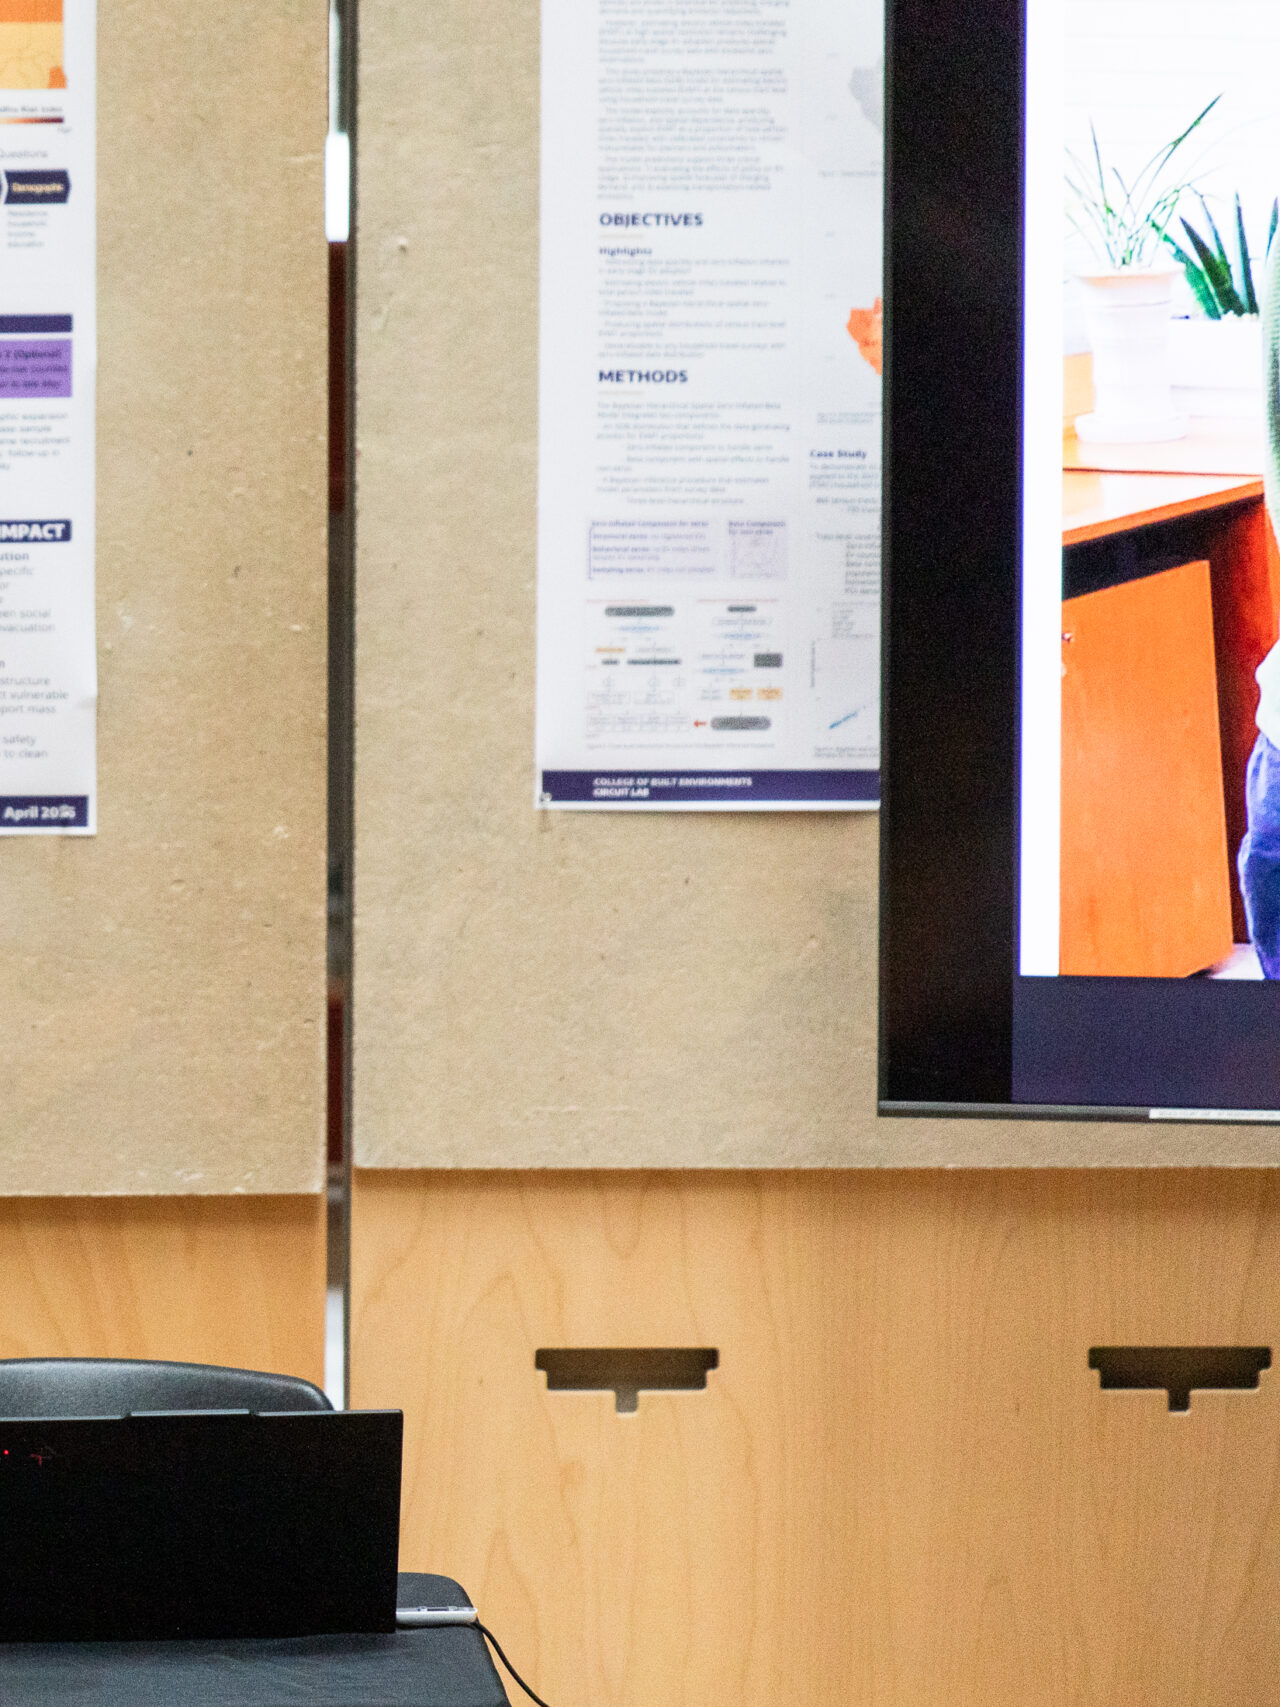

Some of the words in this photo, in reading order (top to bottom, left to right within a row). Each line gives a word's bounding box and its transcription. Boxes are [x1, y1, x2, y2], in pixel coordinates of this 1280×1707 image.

[599, 213, 704, 228] OBJECTIVES
[598, 370, 689, 383] METHODS
[2, 806, 40, 821] April
